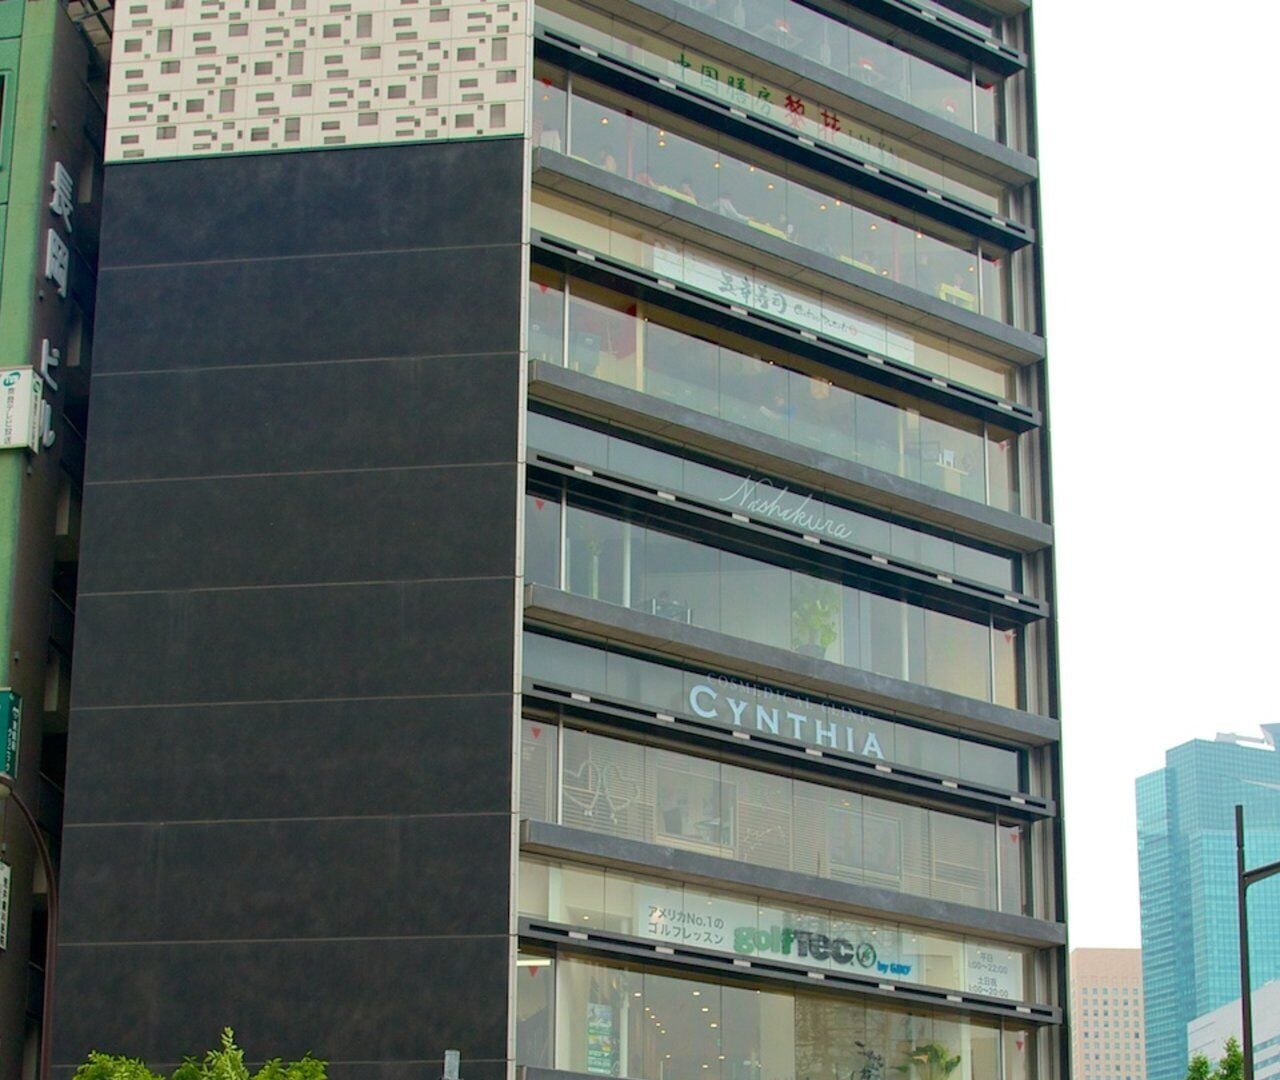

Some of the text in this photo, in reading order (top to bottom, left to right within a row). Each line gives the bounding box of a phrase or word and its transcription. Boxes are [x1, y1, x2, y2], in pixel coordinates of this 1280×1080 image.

[689, 684, 886, 760] CYNTHIA
[648, 920, 724, 945] ゴルフレッスン
